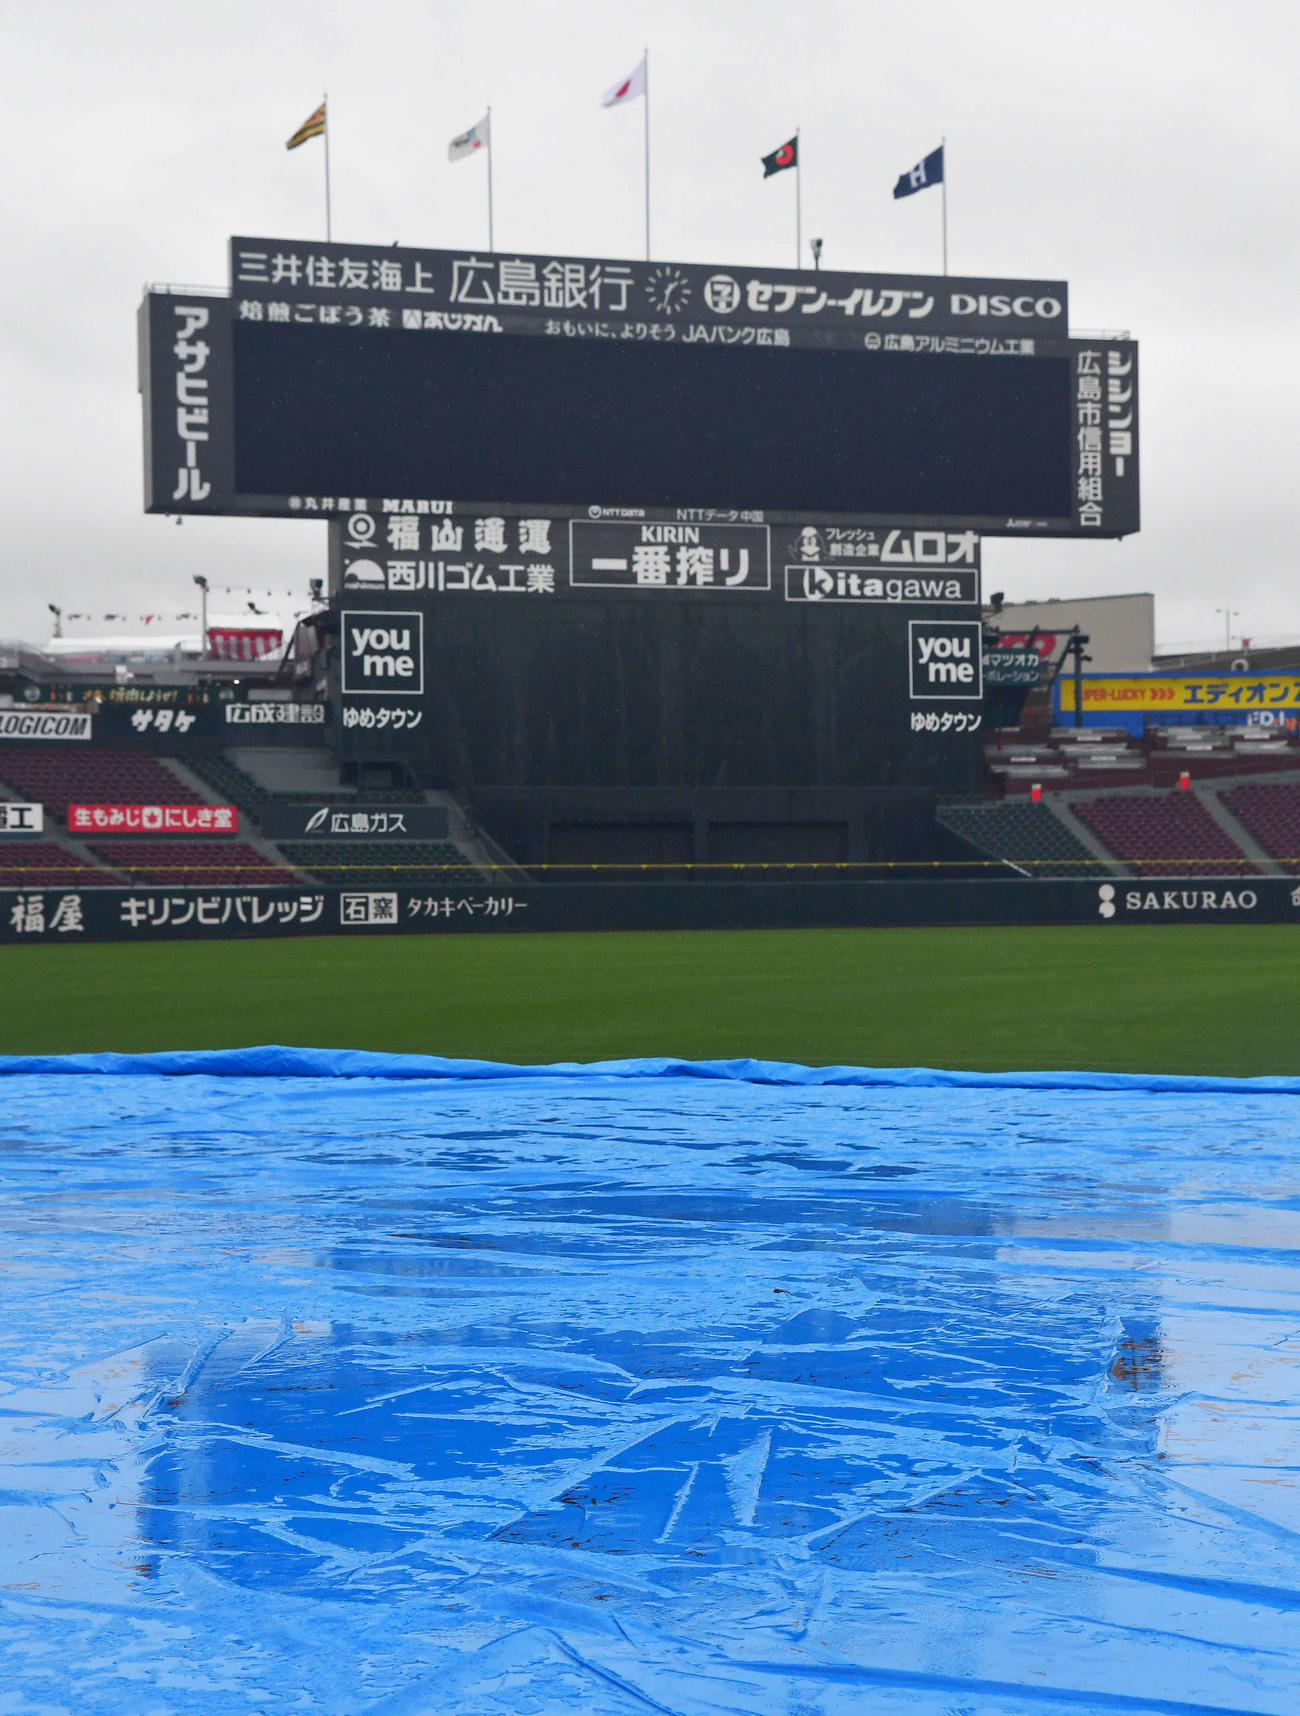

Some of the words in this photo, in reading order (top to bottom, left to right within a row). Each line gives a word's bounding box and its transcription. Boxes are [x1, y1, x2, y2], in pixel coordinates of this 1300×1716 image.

[238, 252, 434, 294] 三井住友海上
[449, 256, 635, 311] 広島銀行
[239, 300, 391, 328] 焙煎ごぼう茶
[950, 293, 1062, 319] DISCO
[545, 318, 677, 342] おもいに、よりそう
[682, 325, 790, 348] JAバンク広島
[884, 333, 1036, 357] 広島アルミニウム工業
[173, 306, 211, 501] アサヒビール
[1108, 350, 1133, 477] シシンヨー
[1077, 349, 1103, 527] 広島市信用組合
[382, 498, 453, 515] MARUI
[641, 525, 700, 544] KIRIN
[826, 527, 875, 541] フレッシュ
[880, 530, 980, 564] ムロオ
[386, 561, 555, 594] 西川ゴム工業
[592, 545, 750, 587] 一番搾り
[351, 628, 411, 657] you
[917, 636, 971, 664] you
[363, 654, 415, 677] me
[928, 662, 975, 683] me
[991, 653, 1040, 668] マツオカ
[131, 708, 197, 733] サタケ
[342, 706, 423, 729] ゆめタウン
[910, 712, 982, 732] ゆめタウン
[75, 807, 140, 827] 生もみじ
[165, 807, 233, 829] にしき堂
[330, 813, 407, 833] 広島ガス
[120, 895, 324, 928] キリンビバレッジ
[407, 896, 528, 917] タカキベーカリー
[1126, 889, 1258, 910] SAKURAO
[10, 894, 84, 933] 福屋
